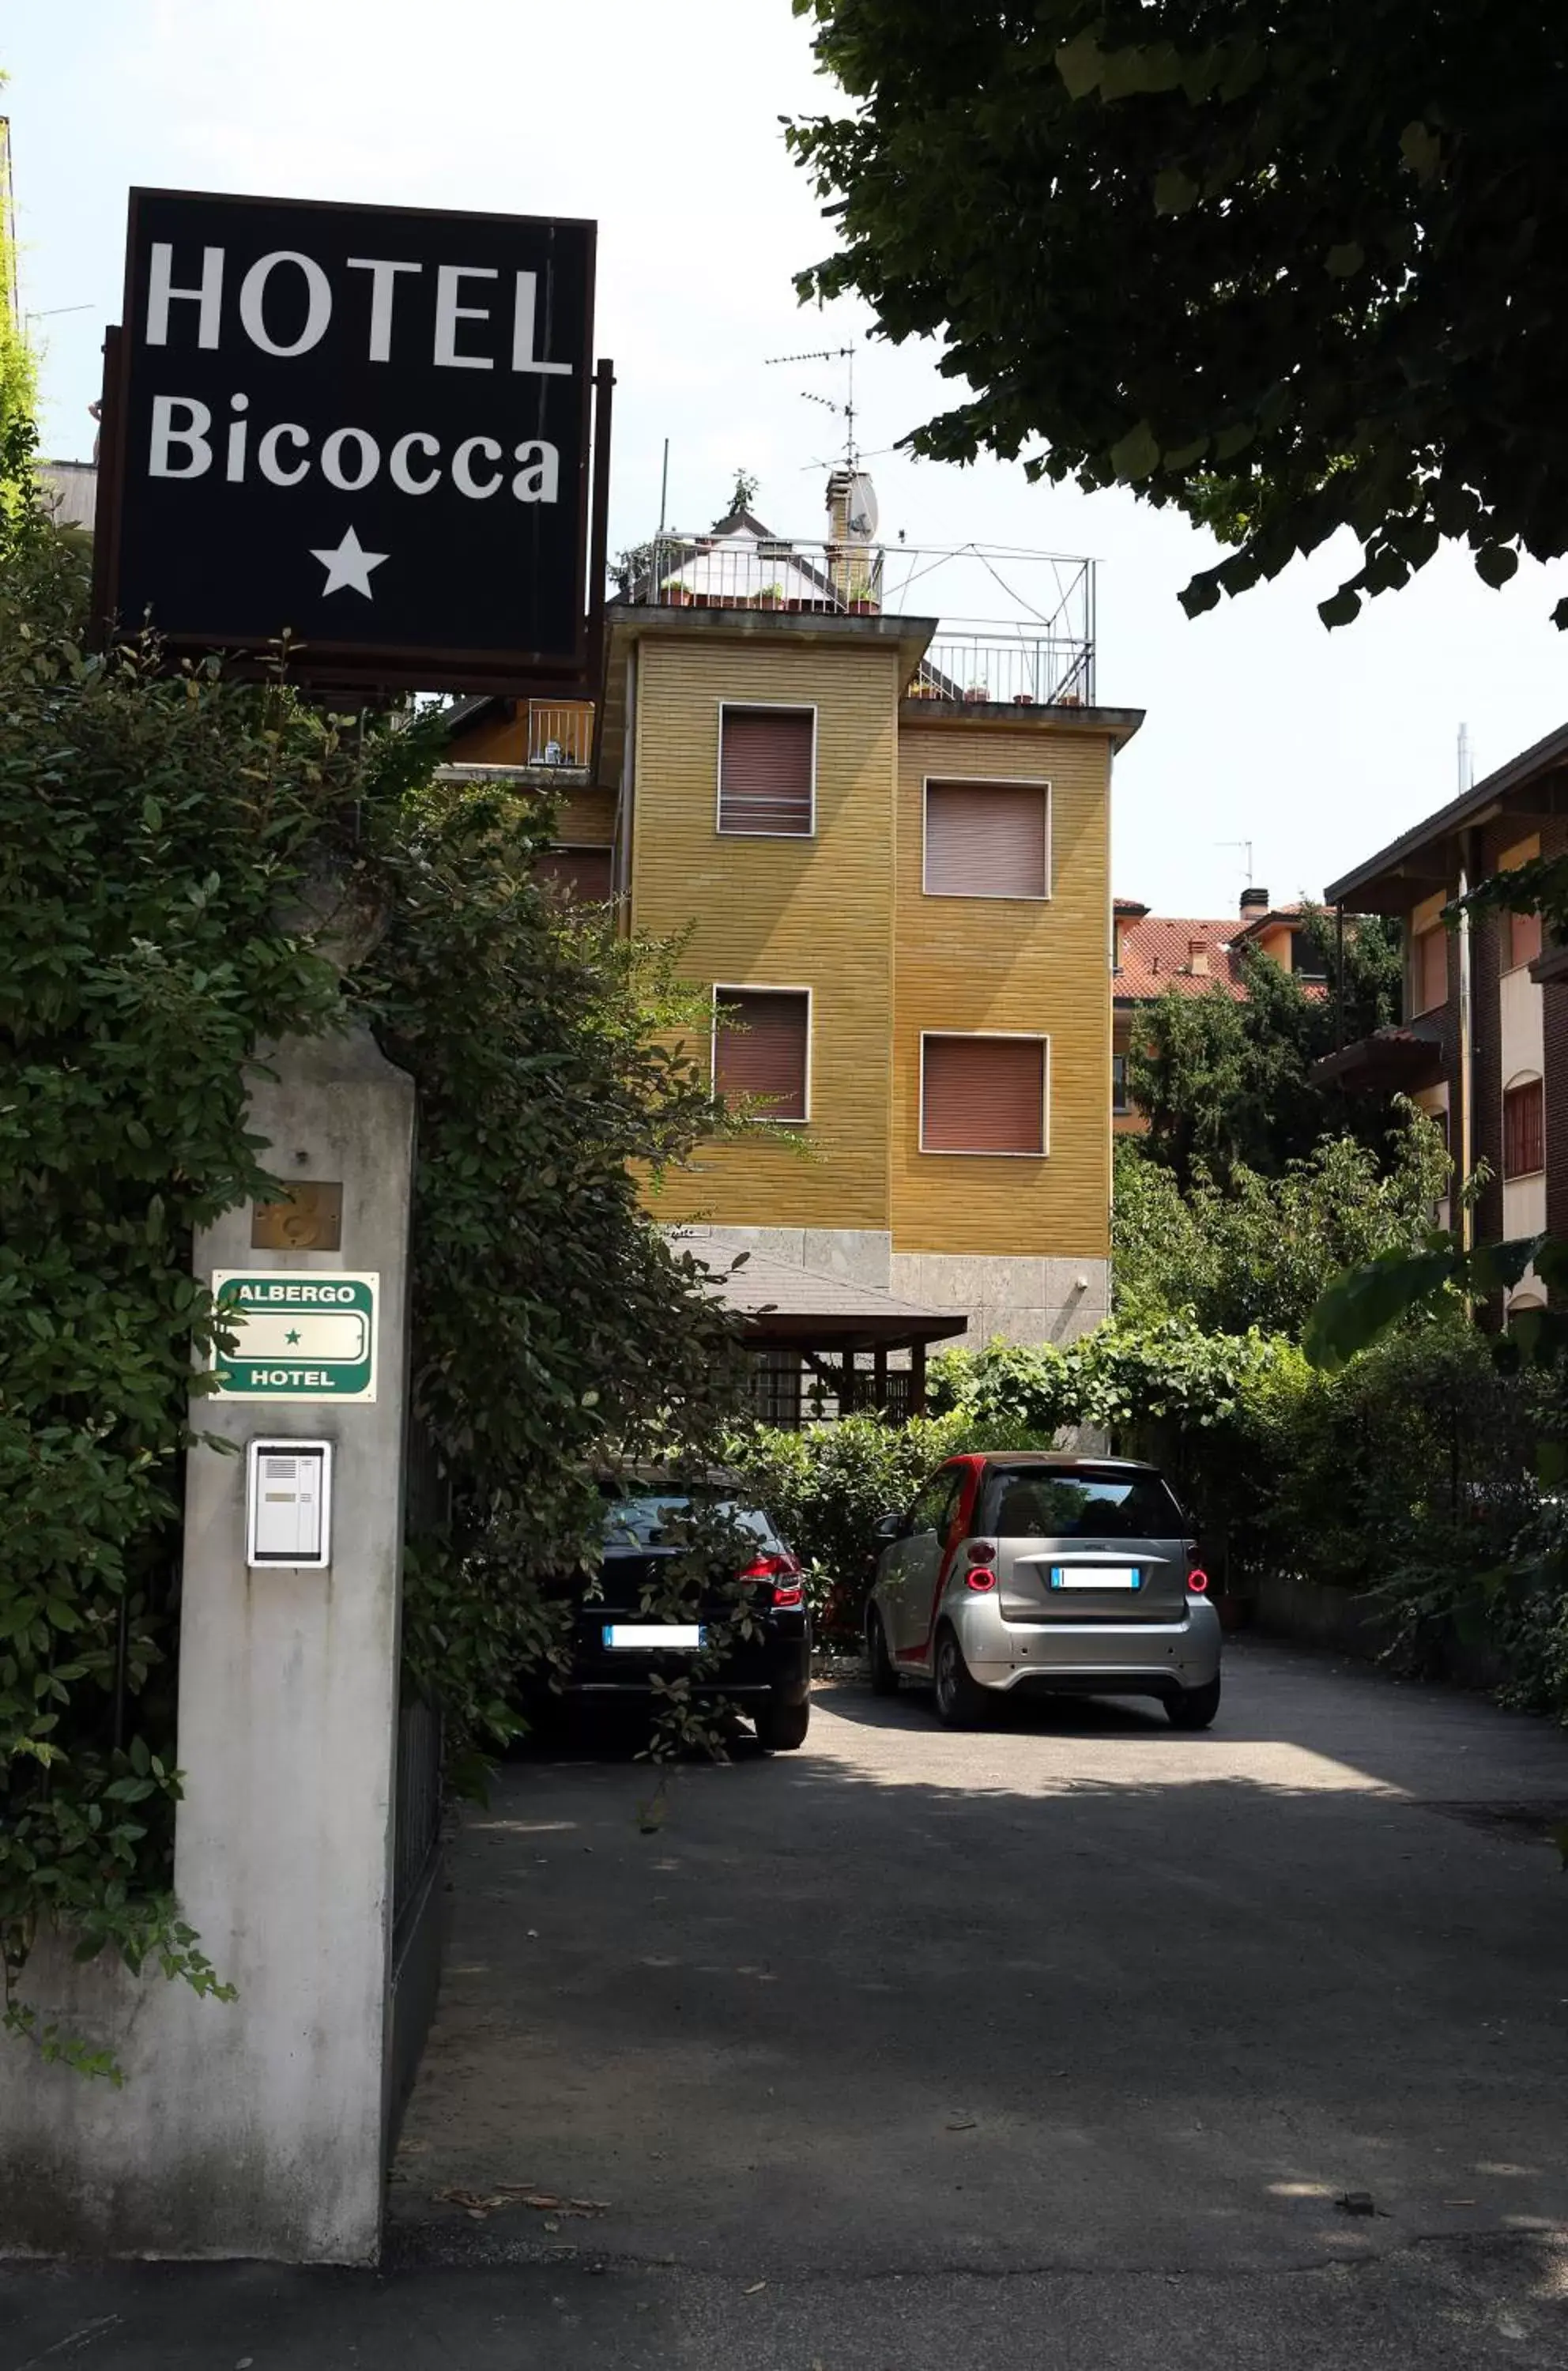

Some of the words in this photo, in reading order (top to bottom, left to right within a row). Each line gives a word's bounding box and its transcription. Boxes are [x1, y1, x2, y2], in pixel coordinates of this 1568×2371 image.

[146, 243, 573, 375] HOTEL
[149, 393, 560, 503] Bicocca
[239, 1284, 356, 1303] ALBERGO
[251, 1369, 336, 1386] HOTEL
